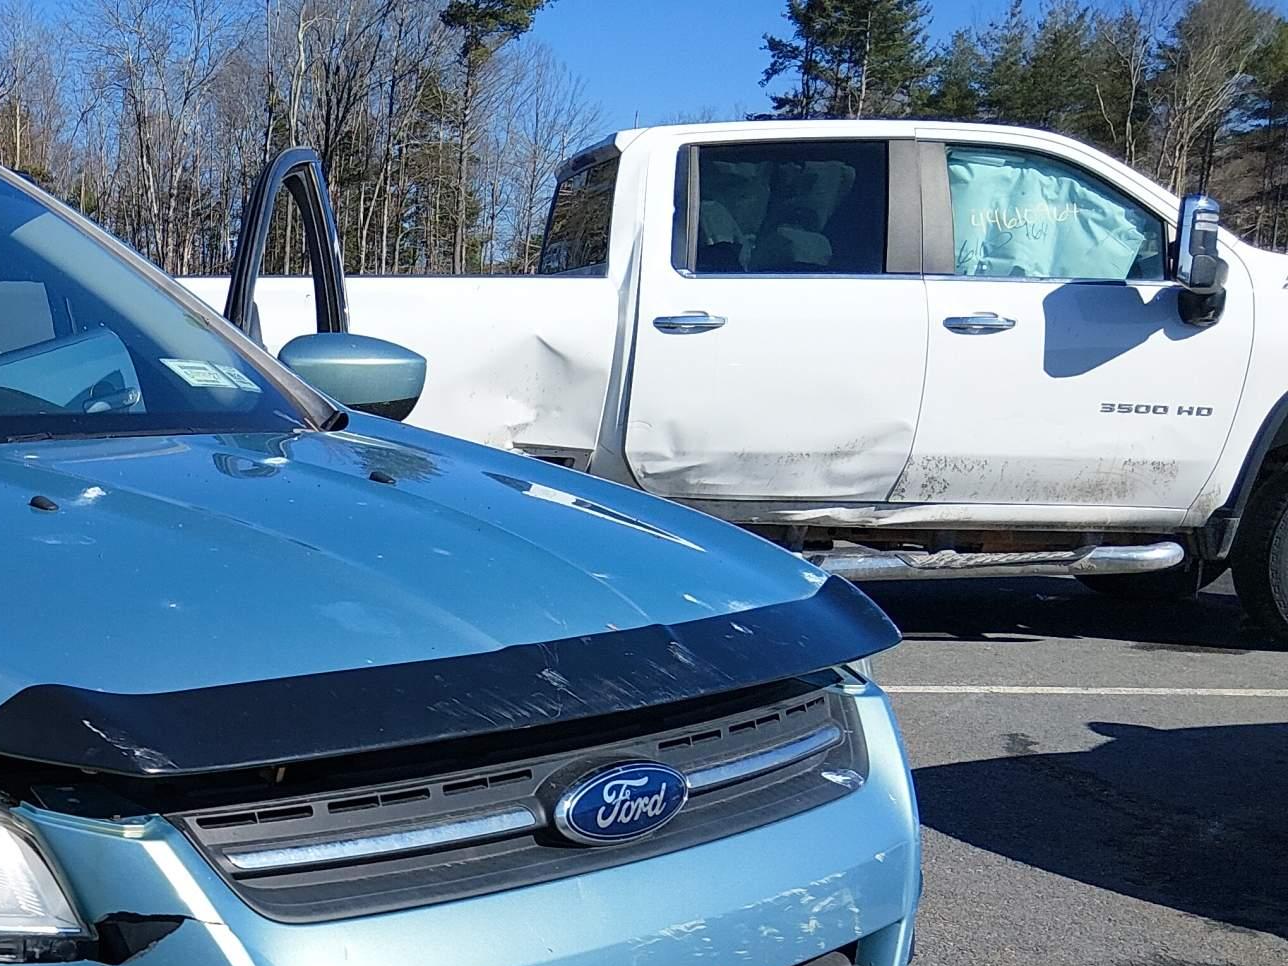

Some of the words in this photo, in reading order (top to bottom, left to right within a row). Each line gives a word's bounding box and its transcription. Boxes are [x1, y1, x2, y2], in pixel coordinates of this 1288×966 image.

[1100, 403, 1169, 415] 3500
[1177, 406, 1213, 417] HD
[597, 776, 666, 828] Ford
